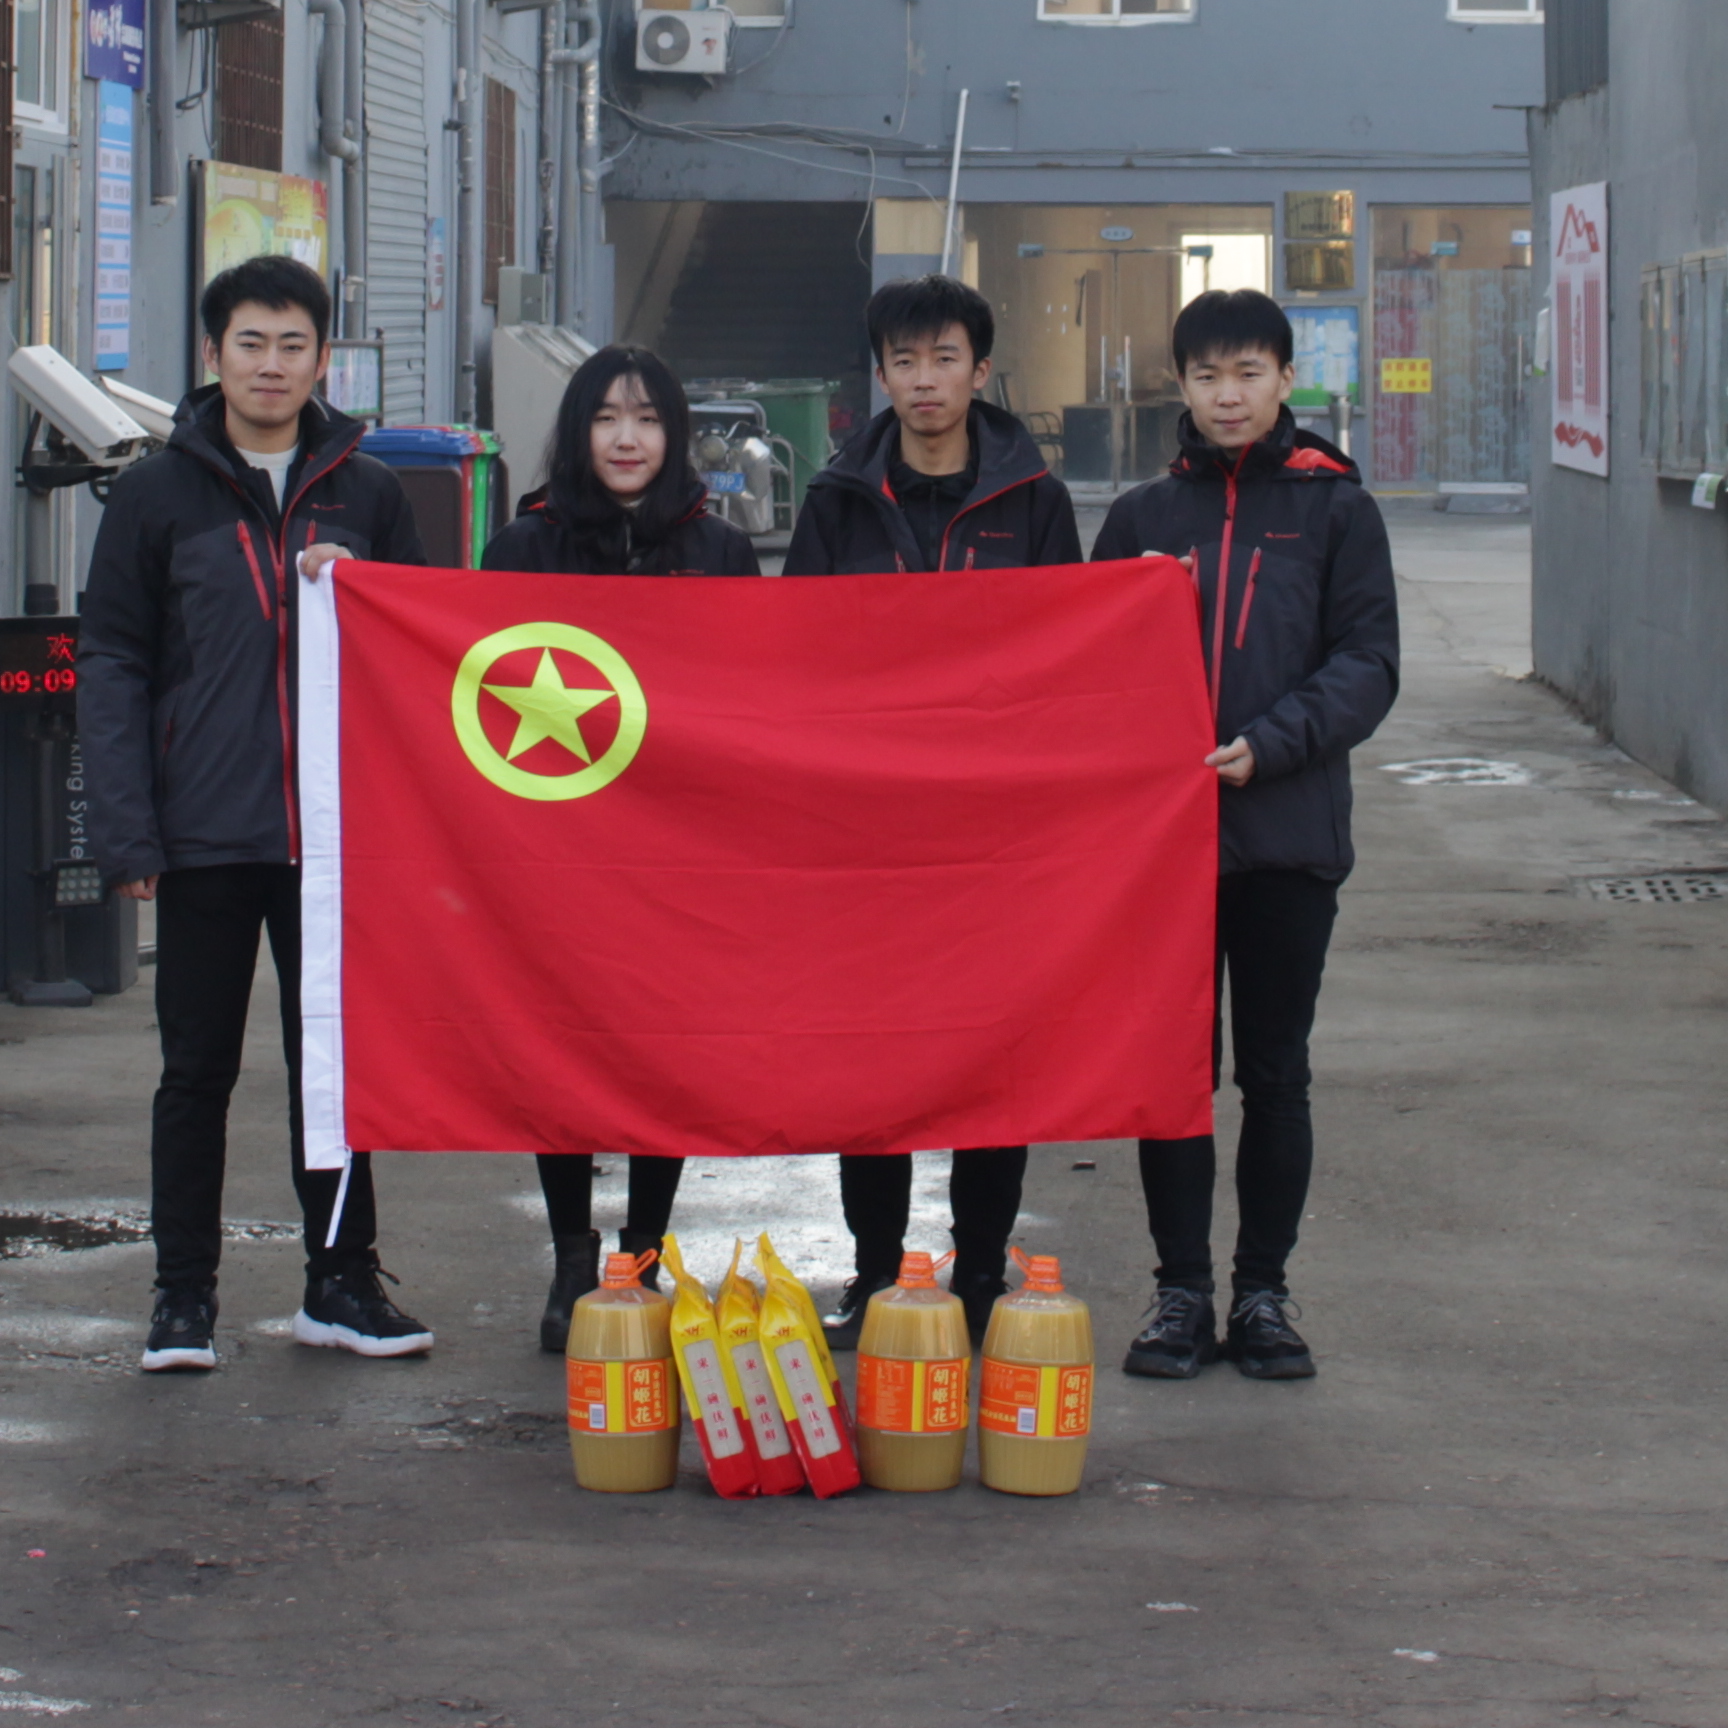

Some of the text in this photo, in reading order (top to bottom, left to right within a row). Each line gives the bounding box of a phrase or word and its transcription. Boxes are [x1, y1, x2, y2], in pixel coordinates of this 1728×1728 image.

[66, 800, 89, 860] Syste
[633, 1368, 652, 1424] 胡姬花
[932, 1368, 950, 1424] 胡姬花
[1064, 1374, 1081, 1429] 胡姬花
